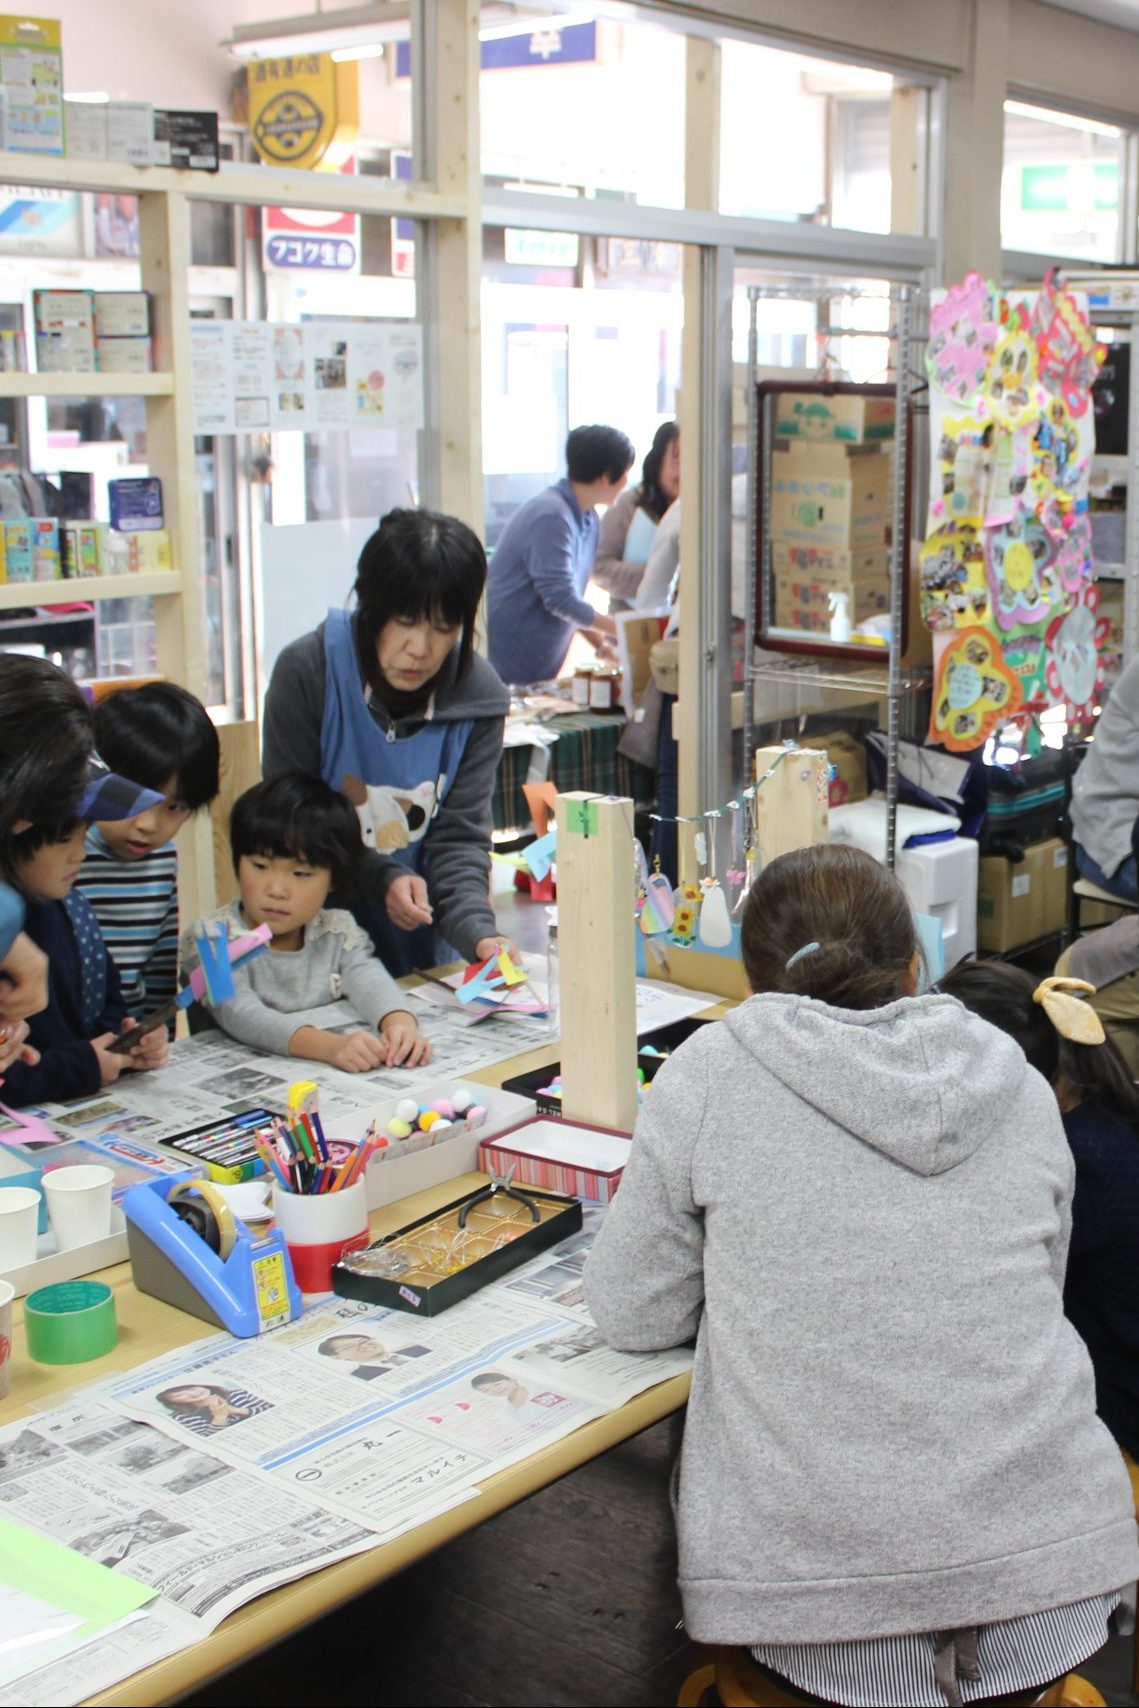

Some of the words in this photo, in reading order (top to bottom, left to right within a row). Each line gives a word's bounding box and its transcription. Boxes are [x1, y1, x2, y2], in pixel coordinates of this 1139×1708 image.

[271, 239, 354, 267] フコク生命
